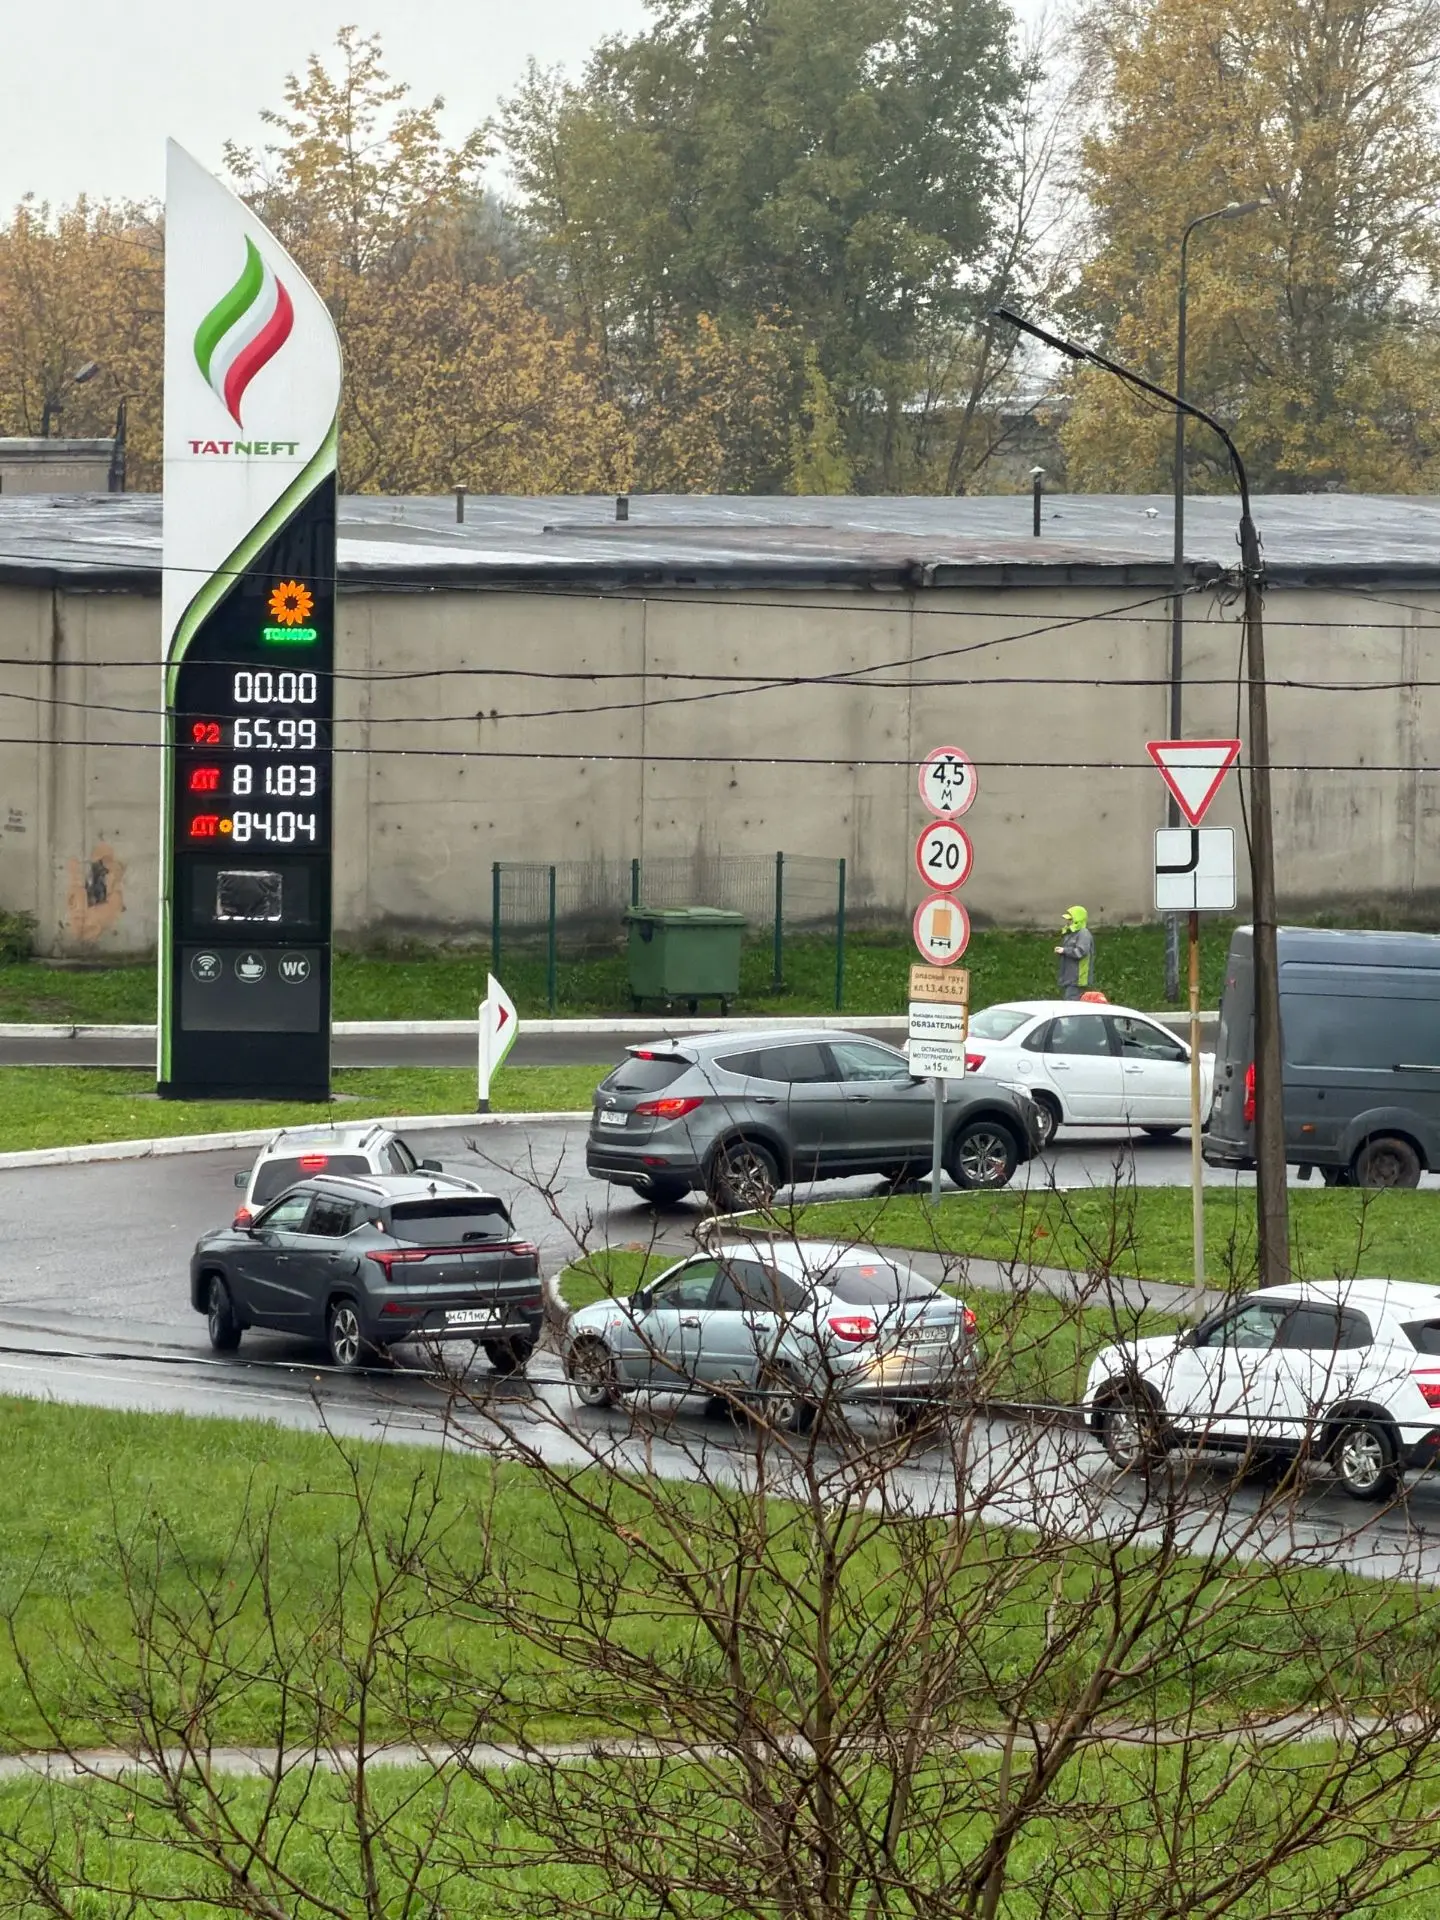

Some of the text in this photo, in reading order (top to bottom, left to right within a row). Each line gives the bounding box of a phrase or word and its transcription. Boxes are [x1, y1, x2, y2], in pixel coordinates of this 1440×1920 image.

[188, 440, 300, 456] TATNEFT
[234, 671, 317, 703] 00.00
[192, 718, 316, 749] 92 65.99
[232, 765, 316, 796] 81.83
[932, 763, 965, 787] 4,5
[232, 811, 316, 842] 84.04
[928, 840, 960, 870] 20
[282, 961, 306, 976] WC
[911, 1020, 965, 1030] ОБЯЗАТЕЛЬНА
[932, 1062, 942, 1072] 15
